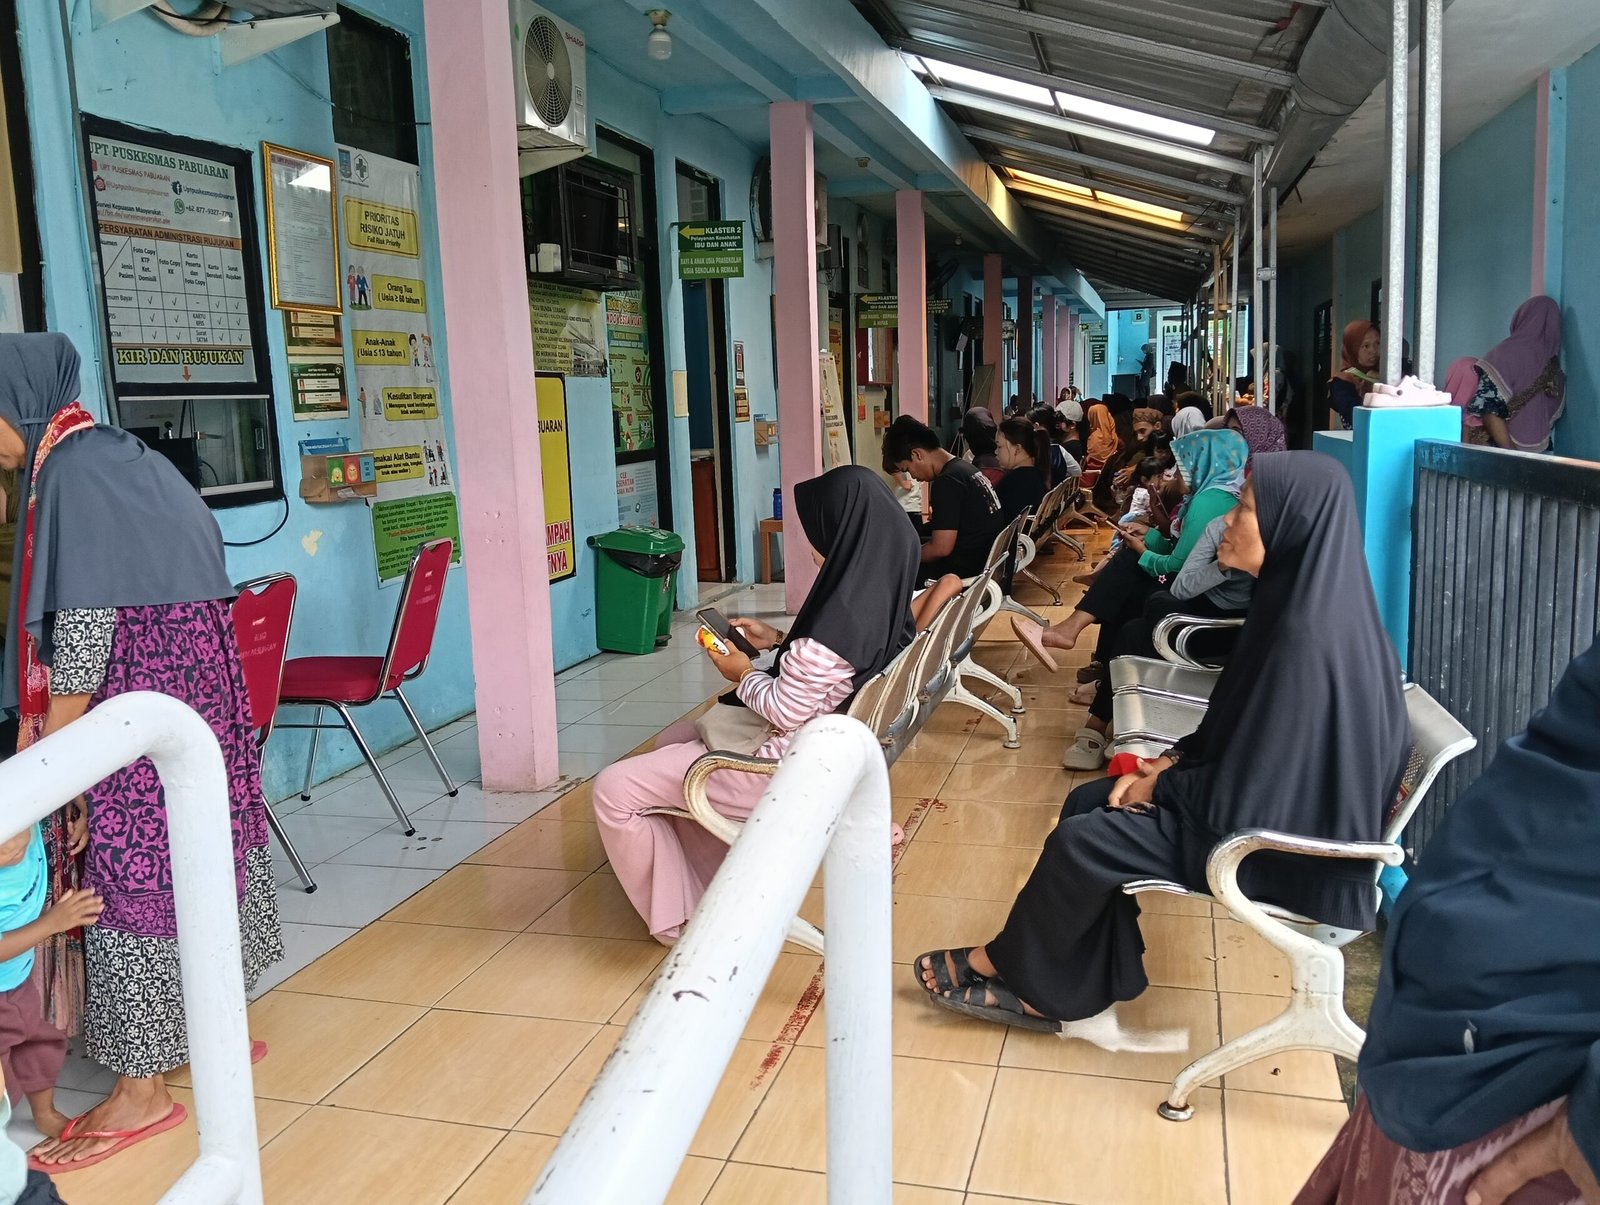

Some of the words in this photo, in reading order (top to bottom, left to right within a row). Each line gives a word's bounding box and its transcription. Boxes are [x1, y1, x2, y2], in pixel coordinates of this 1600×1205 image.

[565, 32, 584, 48] SHARP
[112, 145, 176, 169] PUSKESMAS
[178, 159, 229, 180] PABUARAN
[112, 165, 143, 177] PUSKESMAS
[144, 171, 171, 182] PABUARAN
[364, 210, 400, 226] PRIORITAS
[100, 223, 153, 238] PERSYARATAN
[155, 230, 203, 244] ADMINISTRASI
[204, 237, 234, 248] RUJUKAN
[360, 223, 383, 236] RISIKO
[384, 226, 405, 240] JATUH
[705, 226, 736, 234] KLASTER
[375, 237, 385, 245] Risk
[386, 238, 401, 248] Priority
[144, 248, 155, 256] Copy
[387, 283, 403, 294] Orang
[404, 285, 413, 293] Tua
[382, 293, 394, 302] Usia
[365, 338, 396, 346] Anak-Anak
[117, 348, 146, 365] KIR
[149, 348, 180, 365] DAN
[182, 349, 244, 365] RUJUKAN
[360, 348, 373, 356] Usia
[378, 349, 386, 357] 13
[386, 349, 403, 357] tahun
[387, 392, 412, 400] Kesulitan
[394, 453, 405, 461] Alat
[405, 452, 420, 460] Bantu
